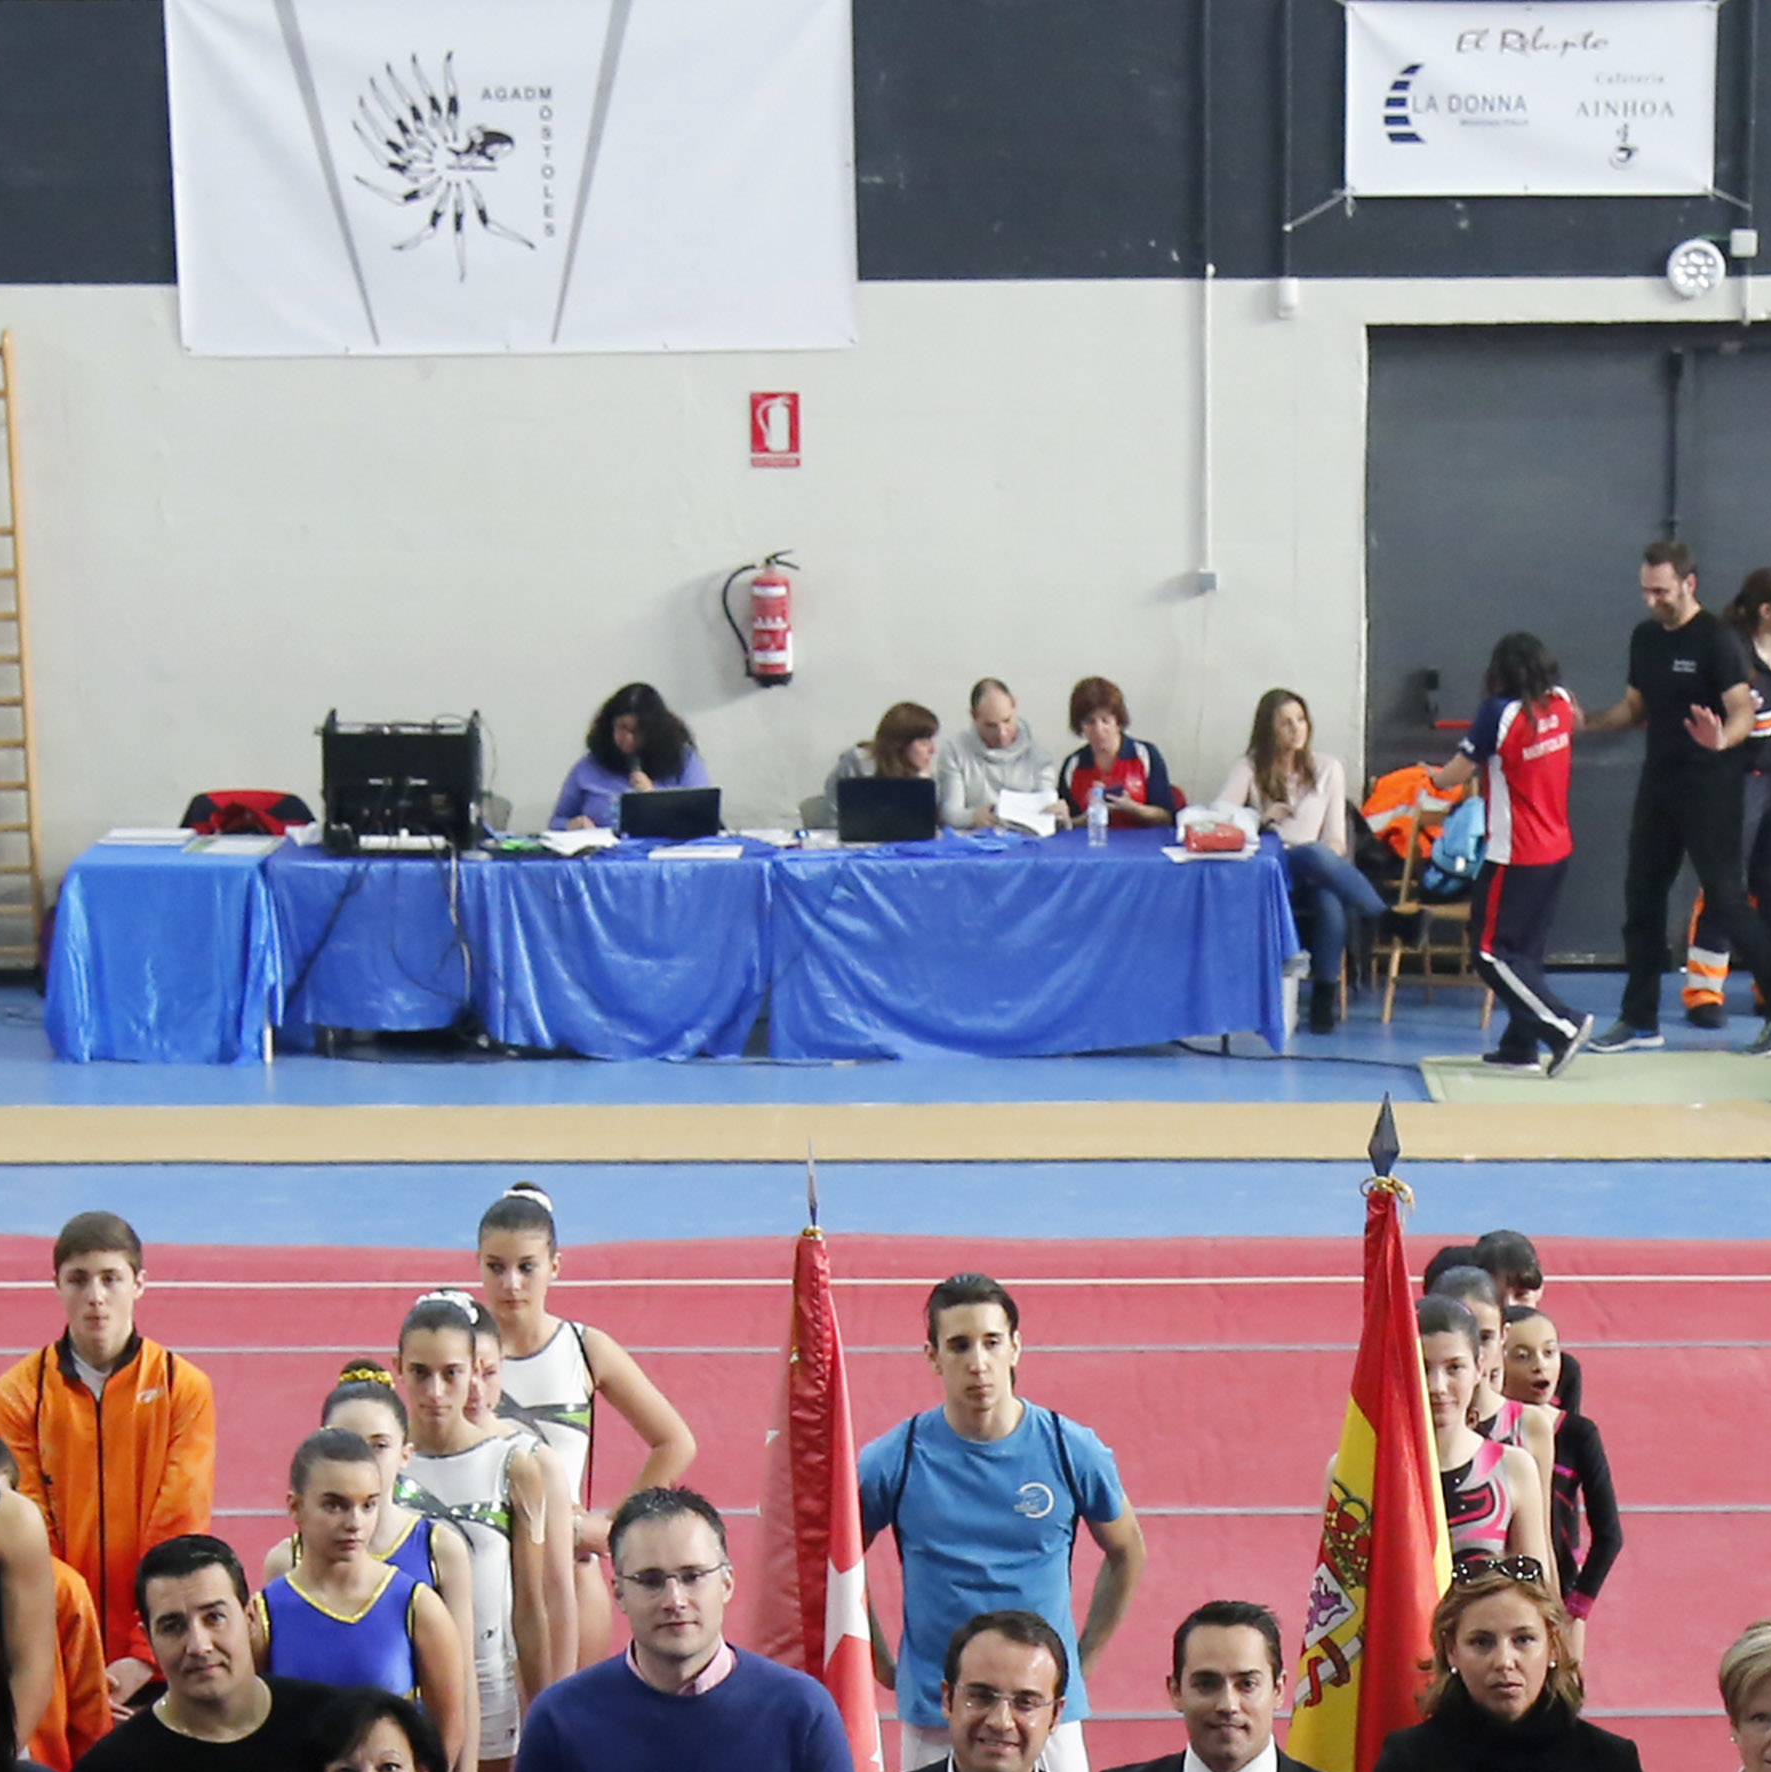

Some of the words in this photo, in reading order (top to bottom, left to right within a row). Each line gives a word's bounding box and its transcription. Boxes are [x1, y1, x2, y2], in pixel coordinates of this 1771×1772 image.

[1412, 94, 1439, 114] LA
[1447, 94, 1528, 114] DONNA
[1576, 99, 1676, 119] AINHOA
